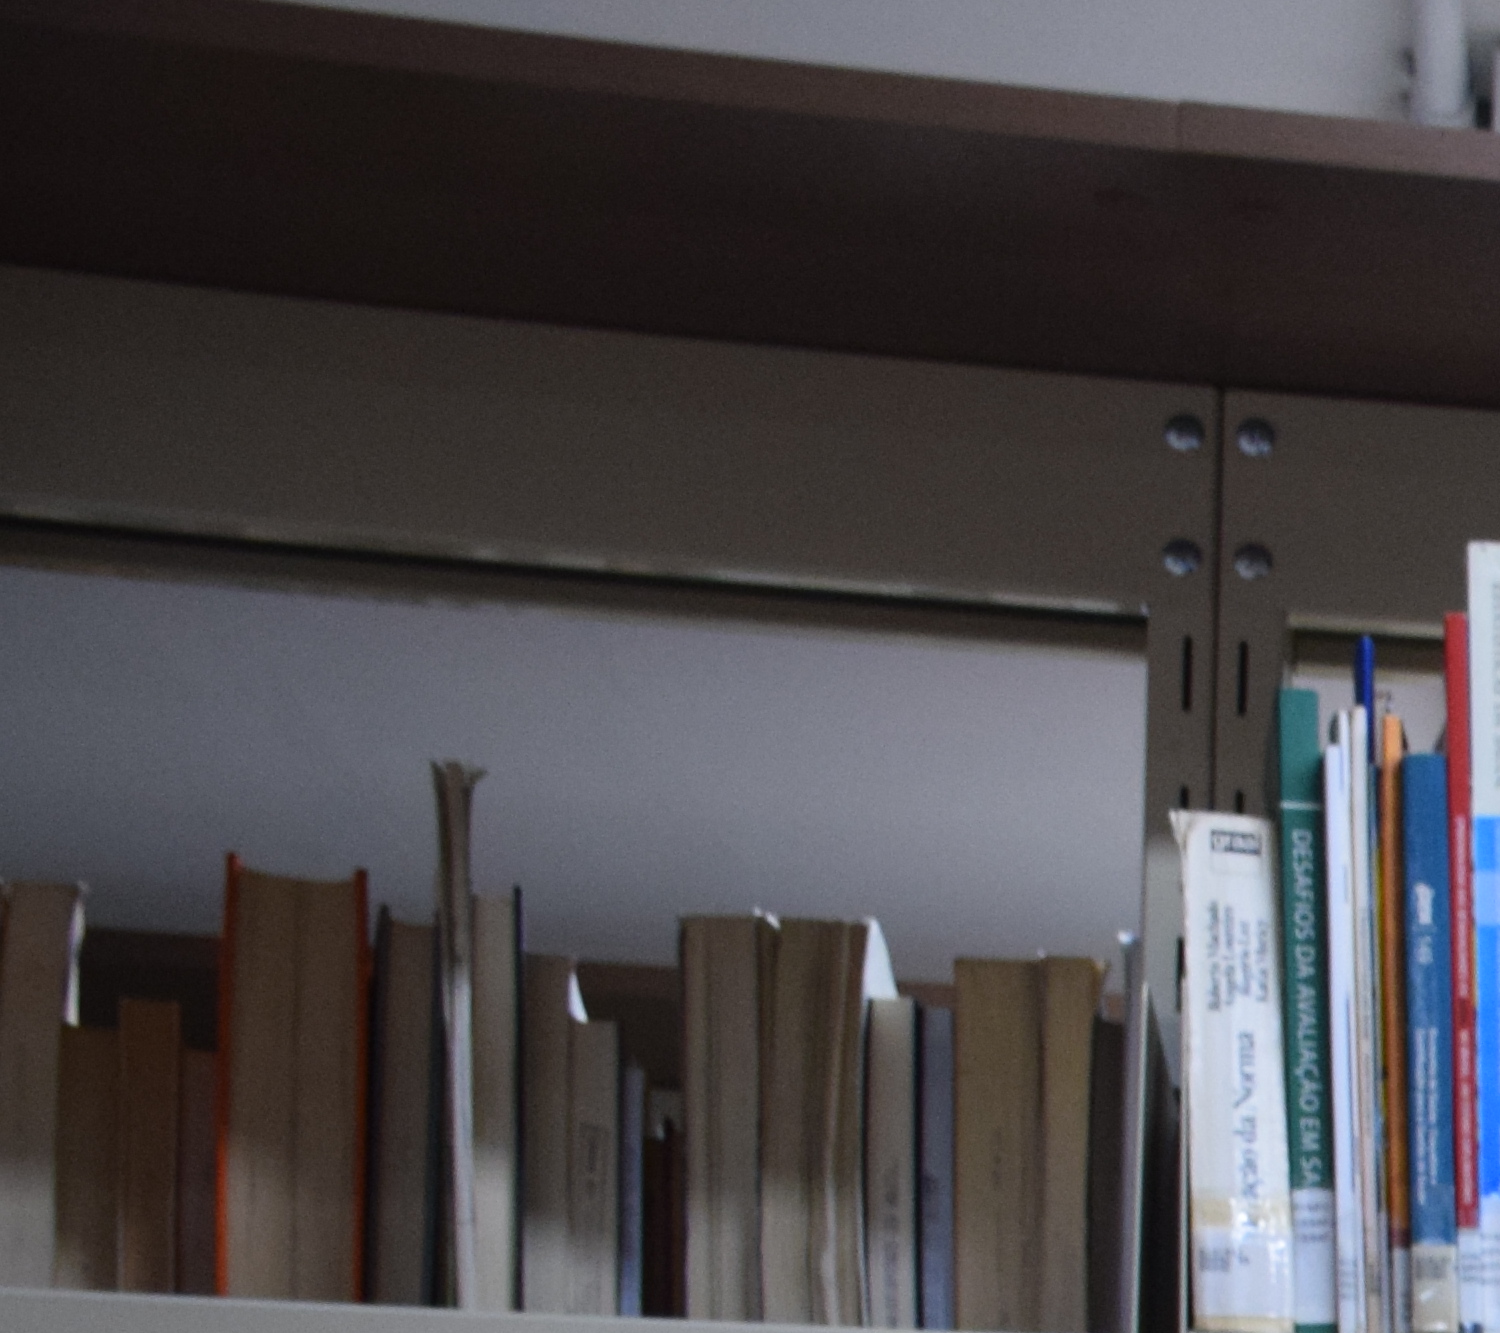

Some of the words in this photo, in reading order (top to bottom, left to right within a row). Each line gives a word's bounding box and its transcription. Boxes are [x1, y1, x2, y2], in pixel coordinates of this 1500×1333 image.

[1293, 829, 1315, 939] DESAFIOS
[1296, 944, 1317, 979] DA
[1295, 981, 1323, 1111] AVALIAÇÃO
[1300, 1117, 1321, 1149] EM
